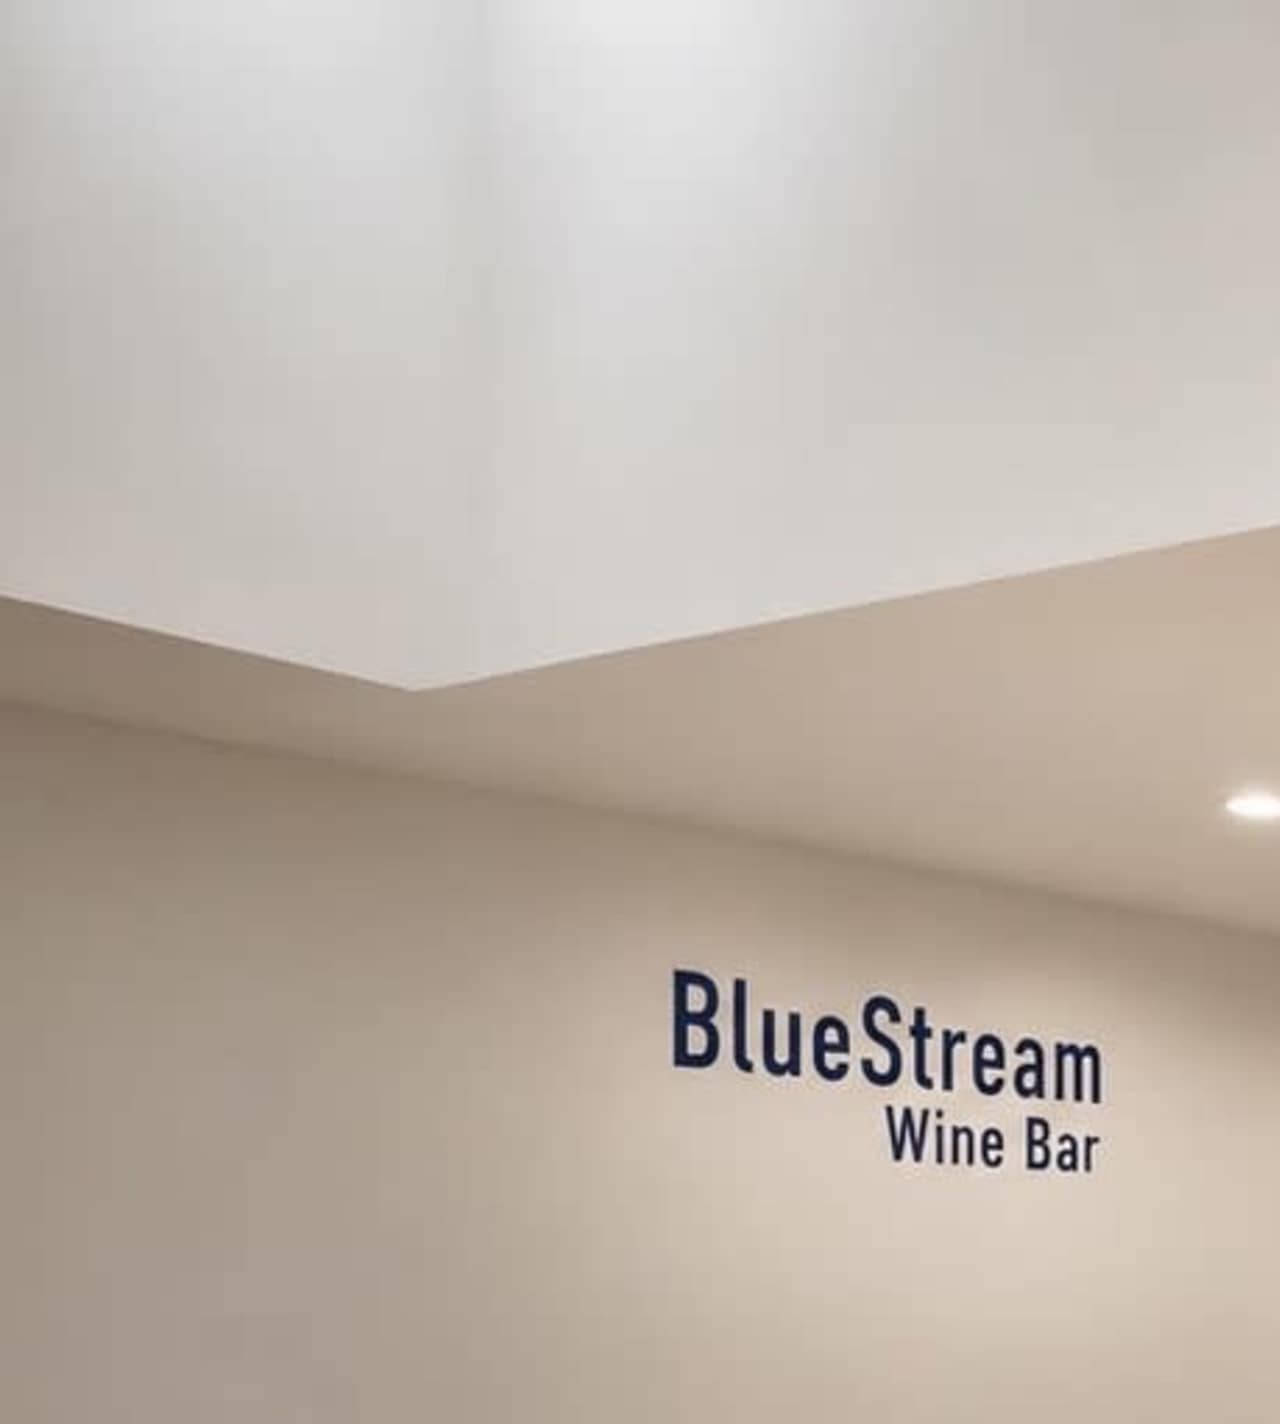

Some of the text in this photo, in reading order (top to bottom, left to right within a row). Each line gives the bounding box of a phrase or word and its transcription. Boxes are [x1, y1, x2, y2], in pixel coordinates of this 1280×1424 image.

[672, 969, 1102, 1103] BlueStream
[886, 1105, 1100, 1173] Wine Bar
